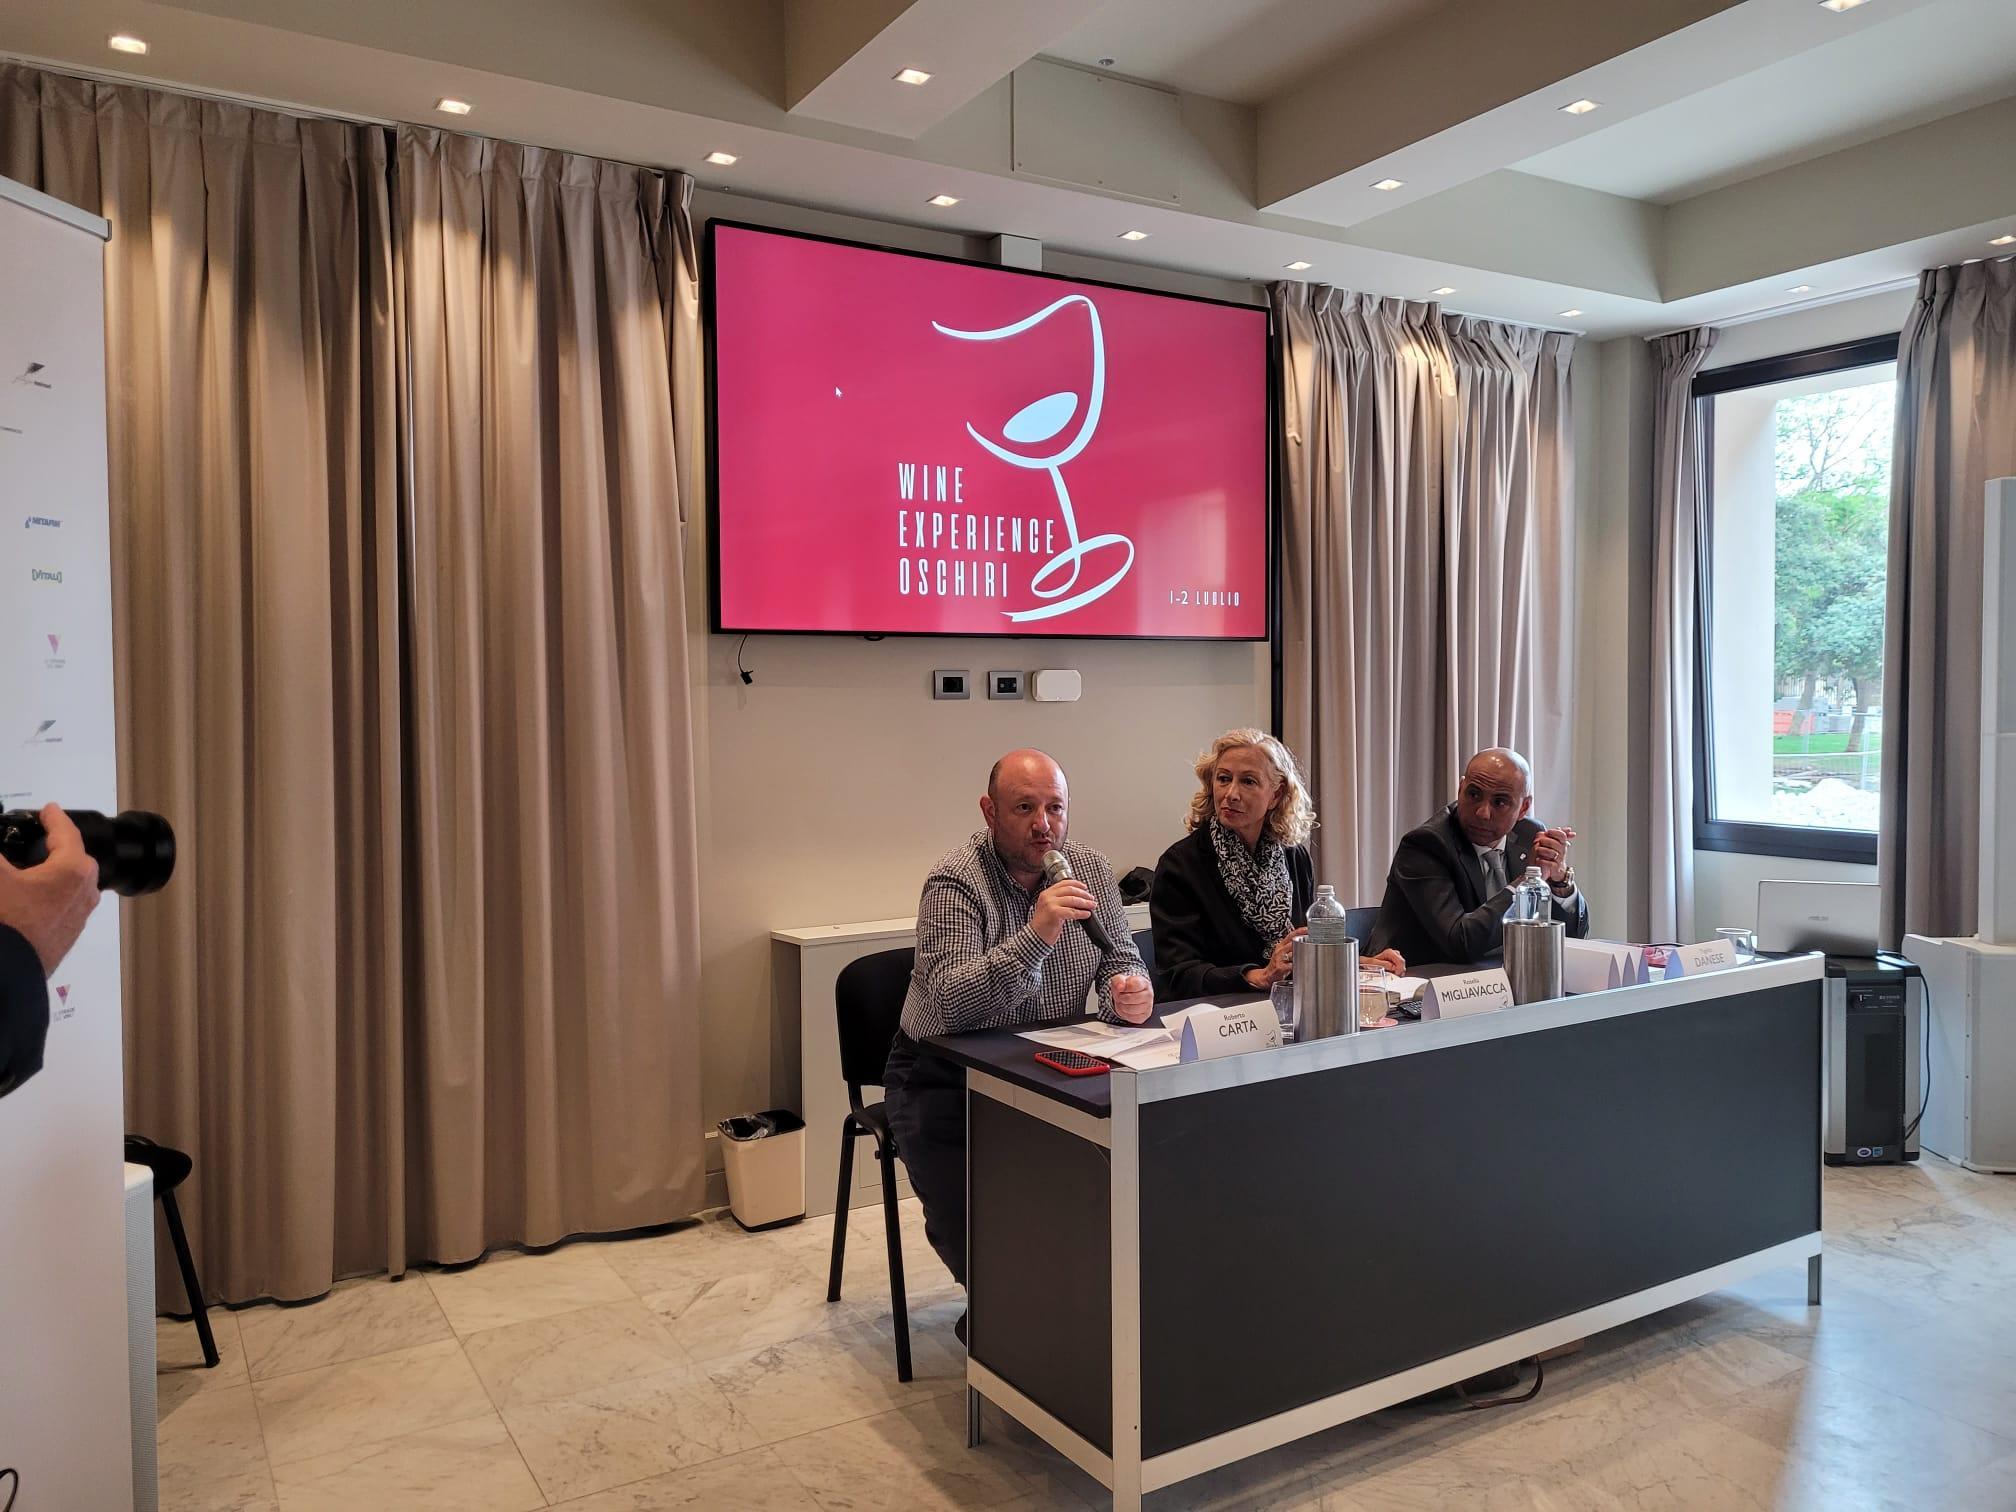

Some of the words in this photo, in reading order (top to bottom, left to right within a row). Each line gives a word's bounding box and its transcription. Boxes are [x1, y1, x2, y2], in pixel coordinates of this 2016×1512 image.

[898, 462, 964, 503] WINE
[898, 510, 1054, 554] EXPERIENCE
[898, 557, 1008, 598] OSCHIRI
[1196, 590, 1240, 607] LUGLIO
[1694, 952, 1725, 968] DANESE
[1441, 982, 1508, 1003] MIGLIAVACCA
[1223, 1013, 1246, 1021] Roberto
[1218, 1019, 1258, 1038] CARTA
